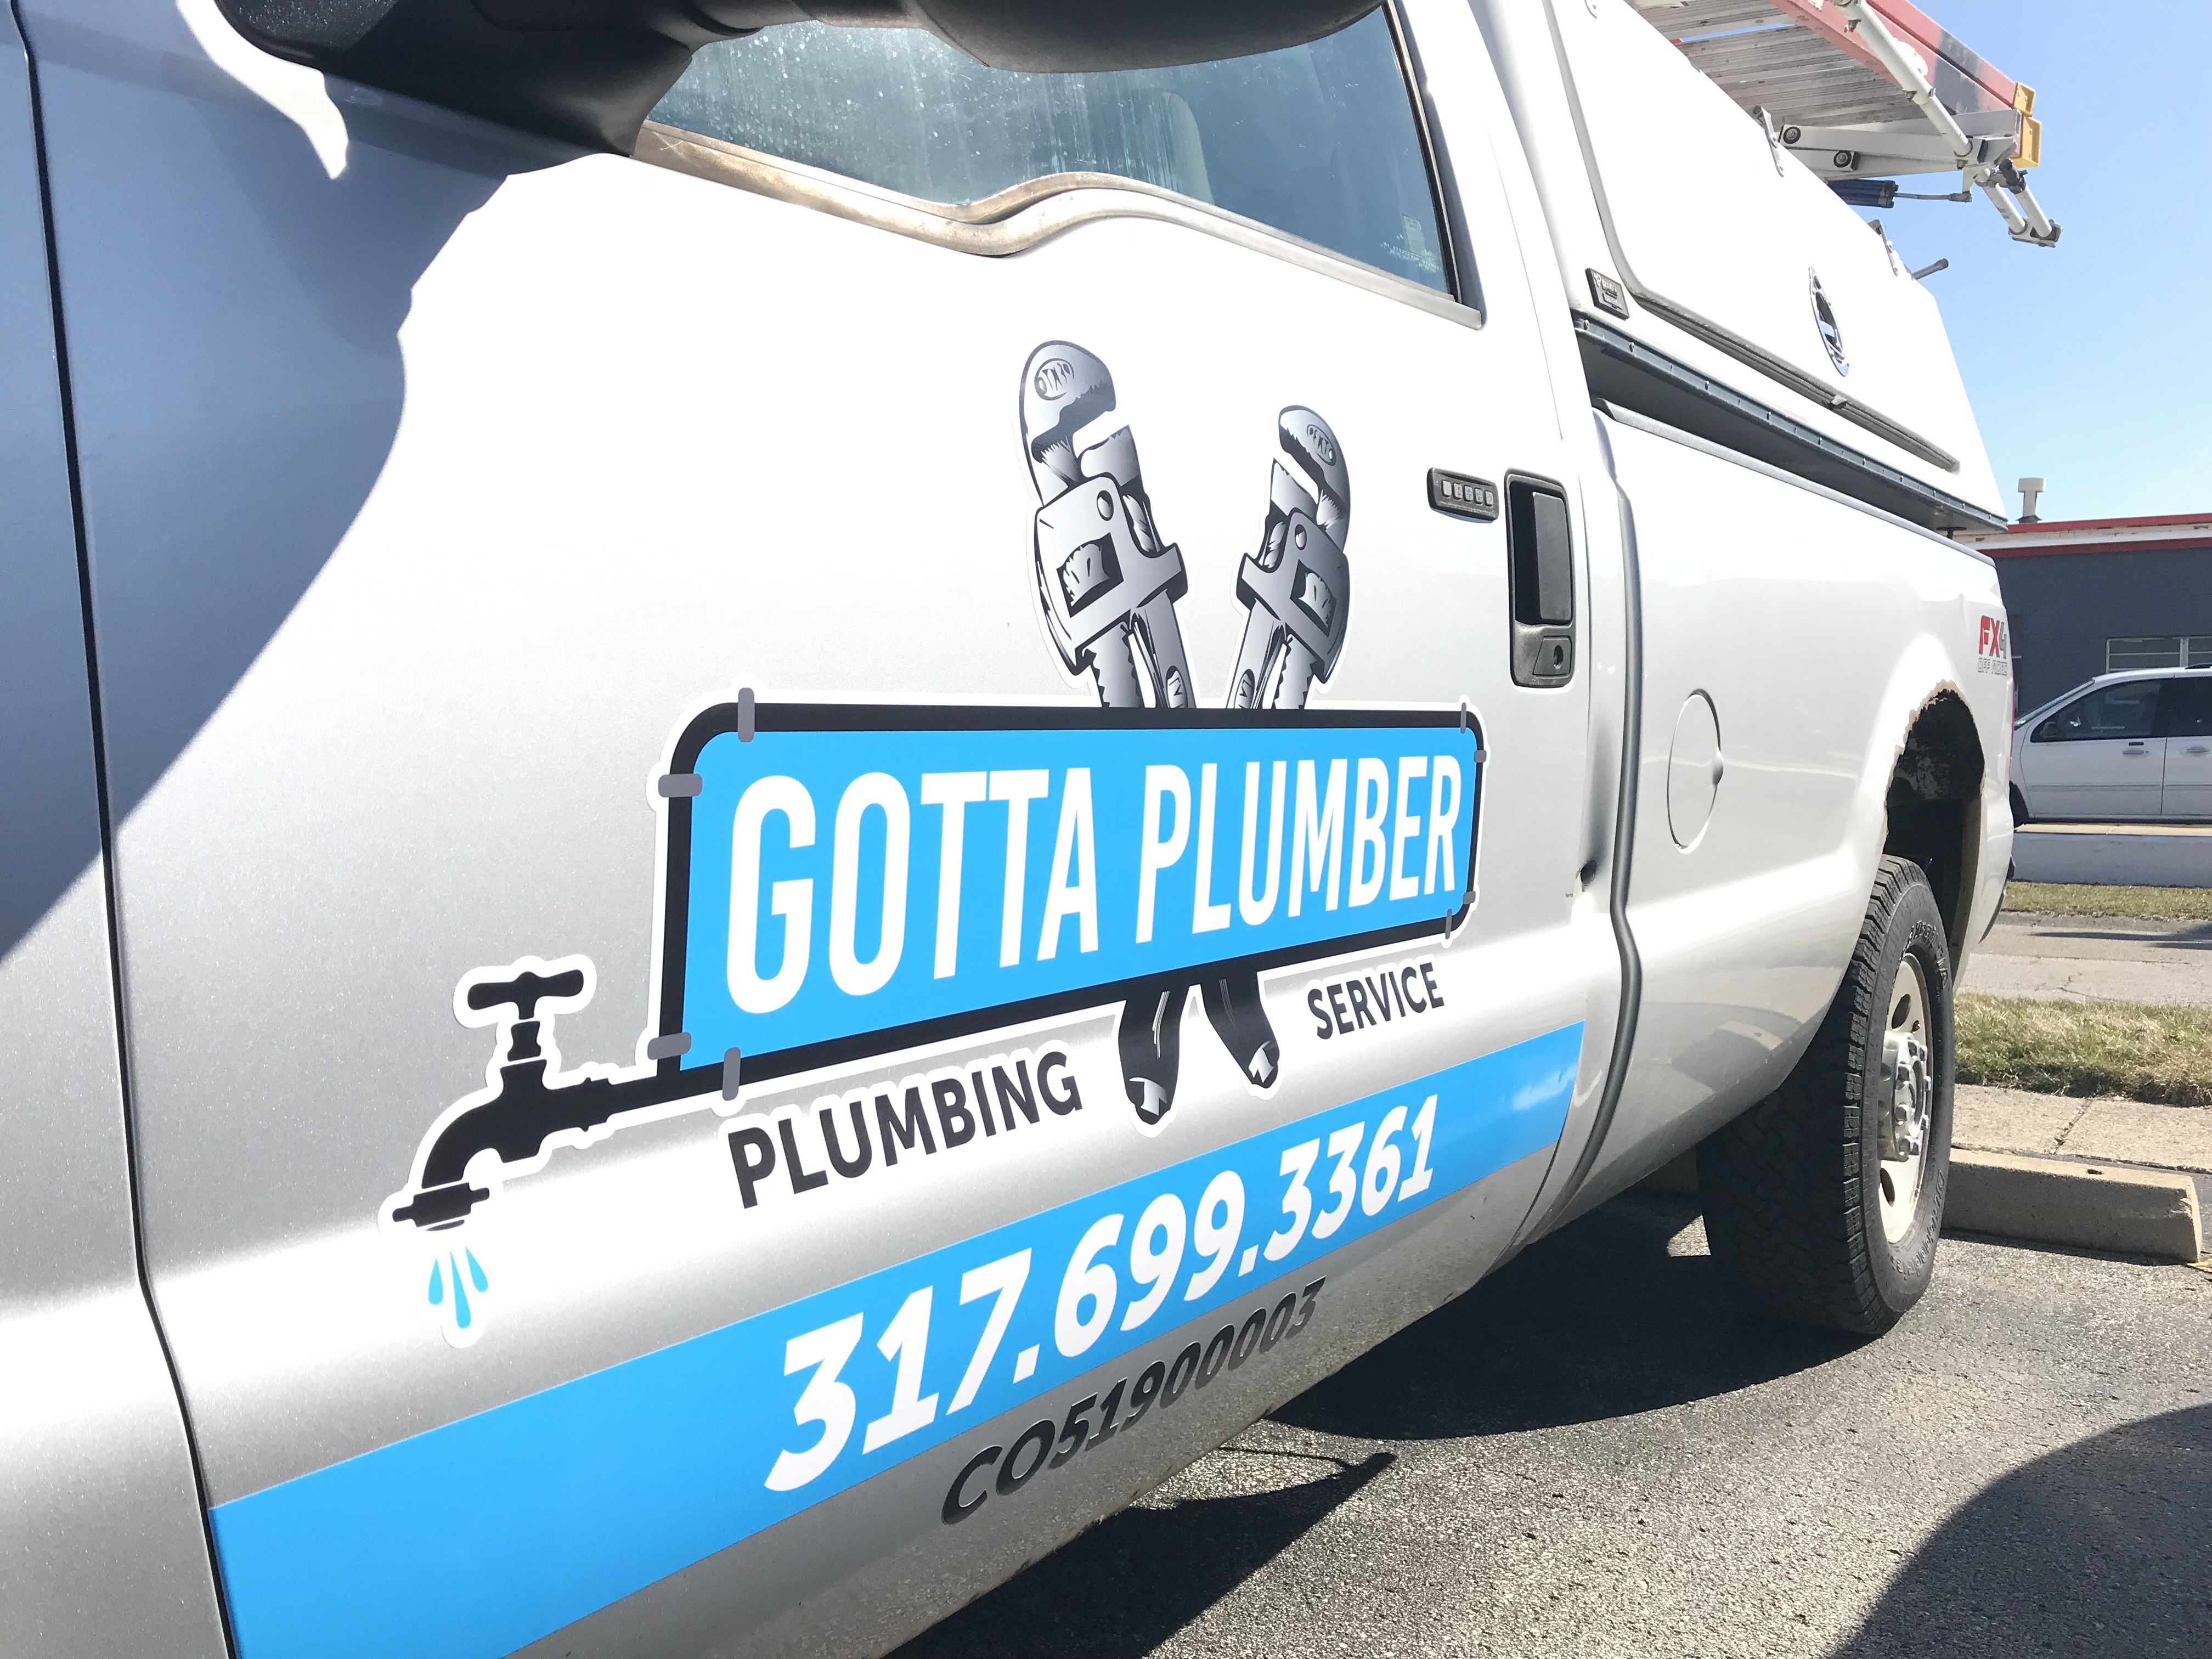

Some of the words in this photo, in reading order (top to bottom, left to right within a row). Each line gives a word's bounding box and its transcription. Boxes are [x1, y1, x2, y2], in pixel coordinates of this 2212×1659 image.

[1979, 615, 2007, 659] FX4
[727, 768, 1098, 1013] GOTTA
[1136, 755, 1462, 944] PLUMBER
[728, 1051, 1082, 1209] PLUMBING
[1307, 962, 1444, 1040] SERVICE
[764, 1094, 1438, 1492] 317.699.3361
[941, 1275, 1327, 1525] CO51900003
